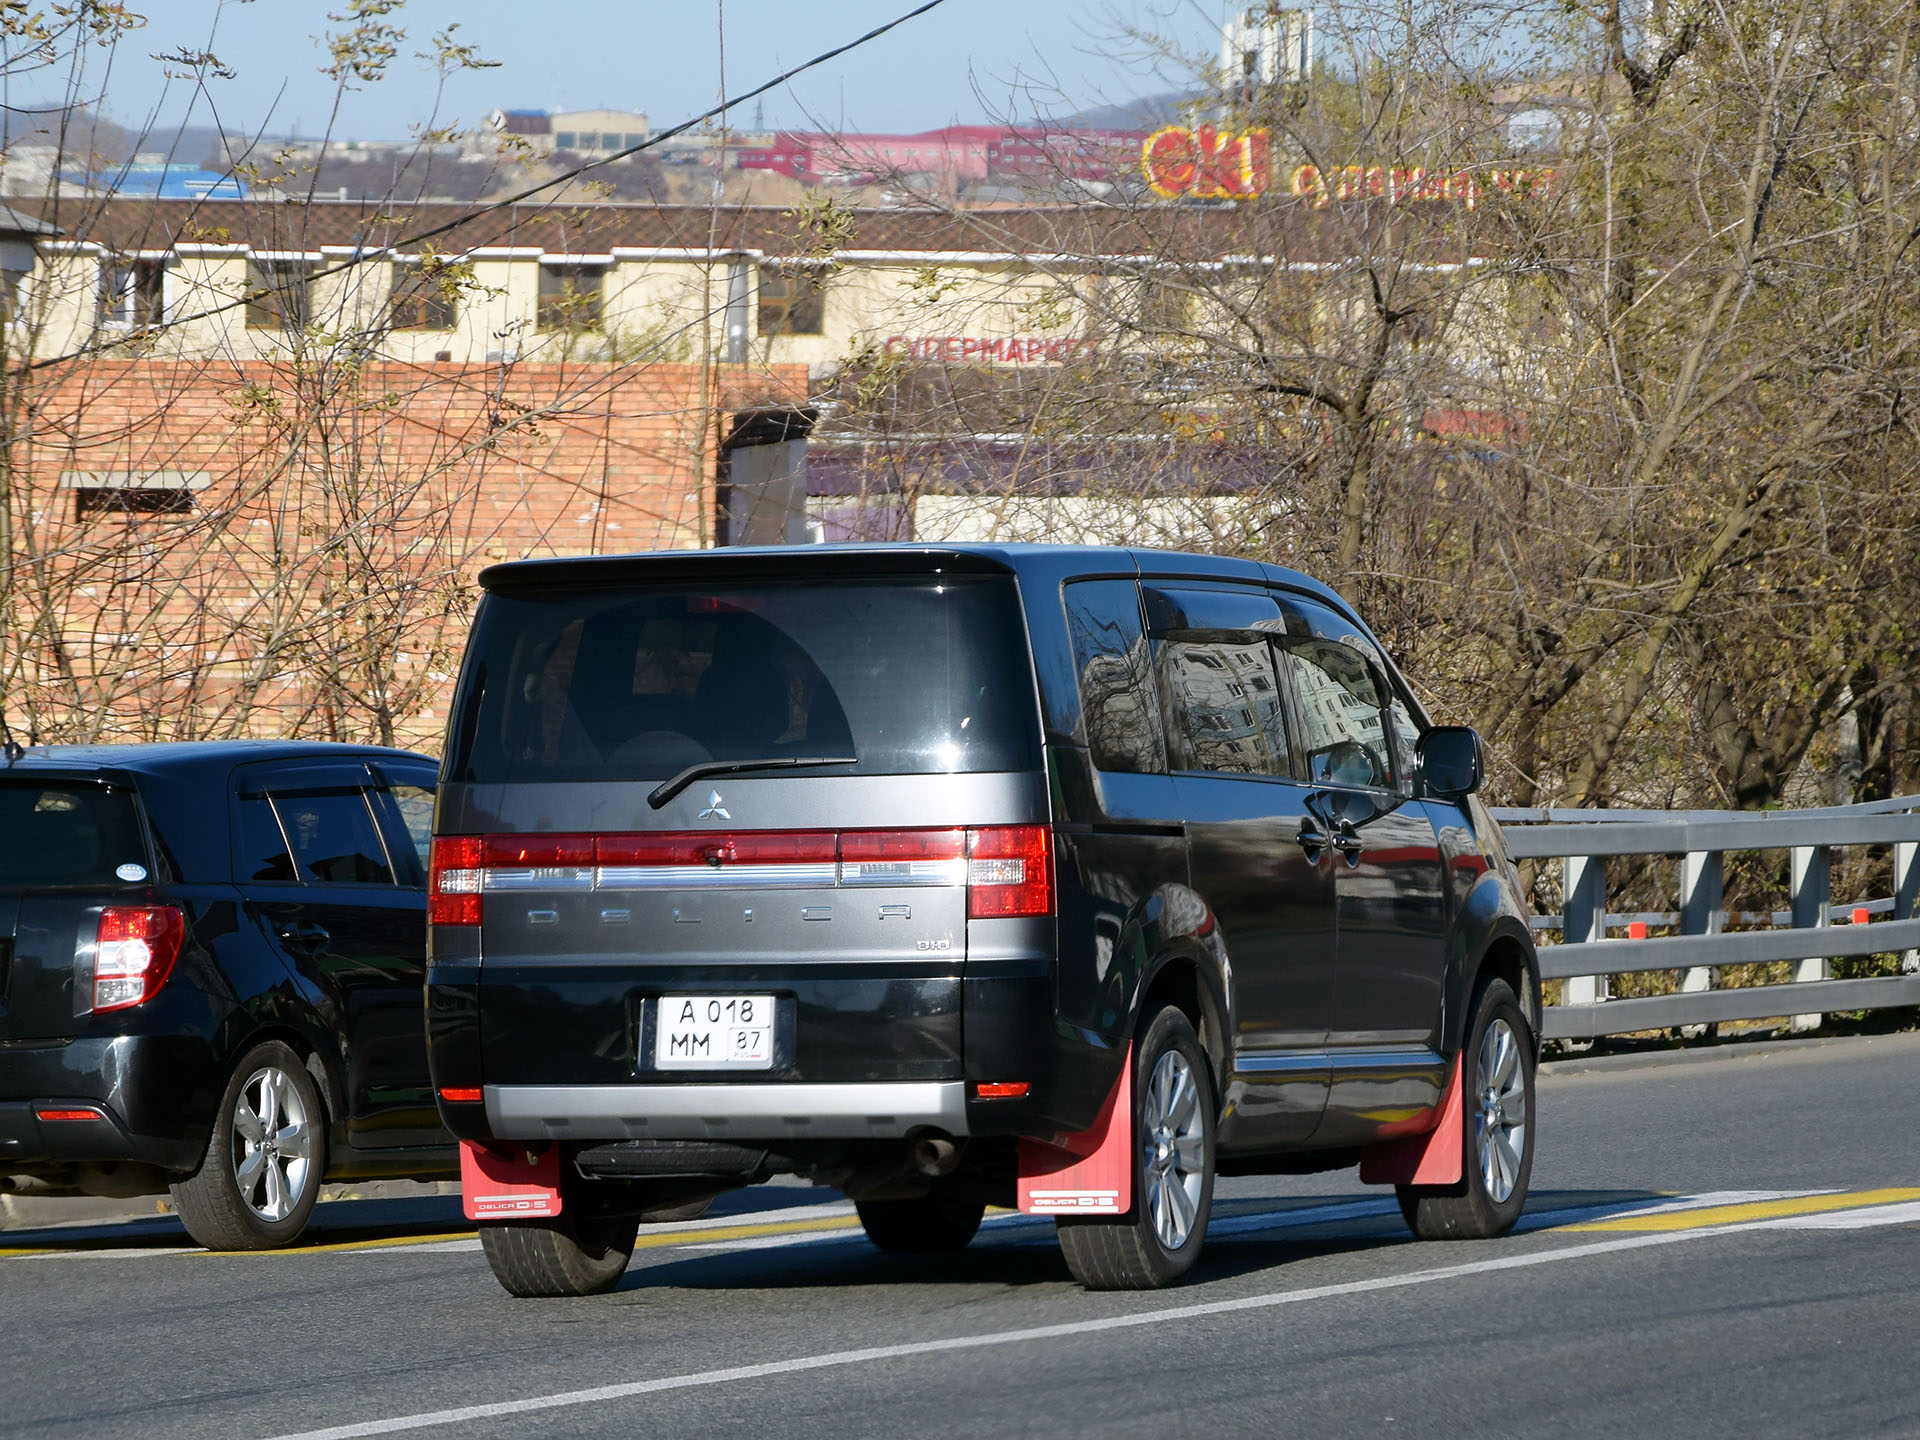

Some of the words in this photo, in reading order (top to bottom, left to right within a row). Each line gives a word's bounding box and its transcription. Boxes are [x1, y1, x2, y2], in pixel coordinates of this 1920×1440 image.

[528, 904, 912, 922] DELICA
[680, 1000, 695, 1023] А
[707, 999, 753, 1023] 018
[670, 1032, 711, 1056] ММ
[736, 1031, 760, 1050] 87
